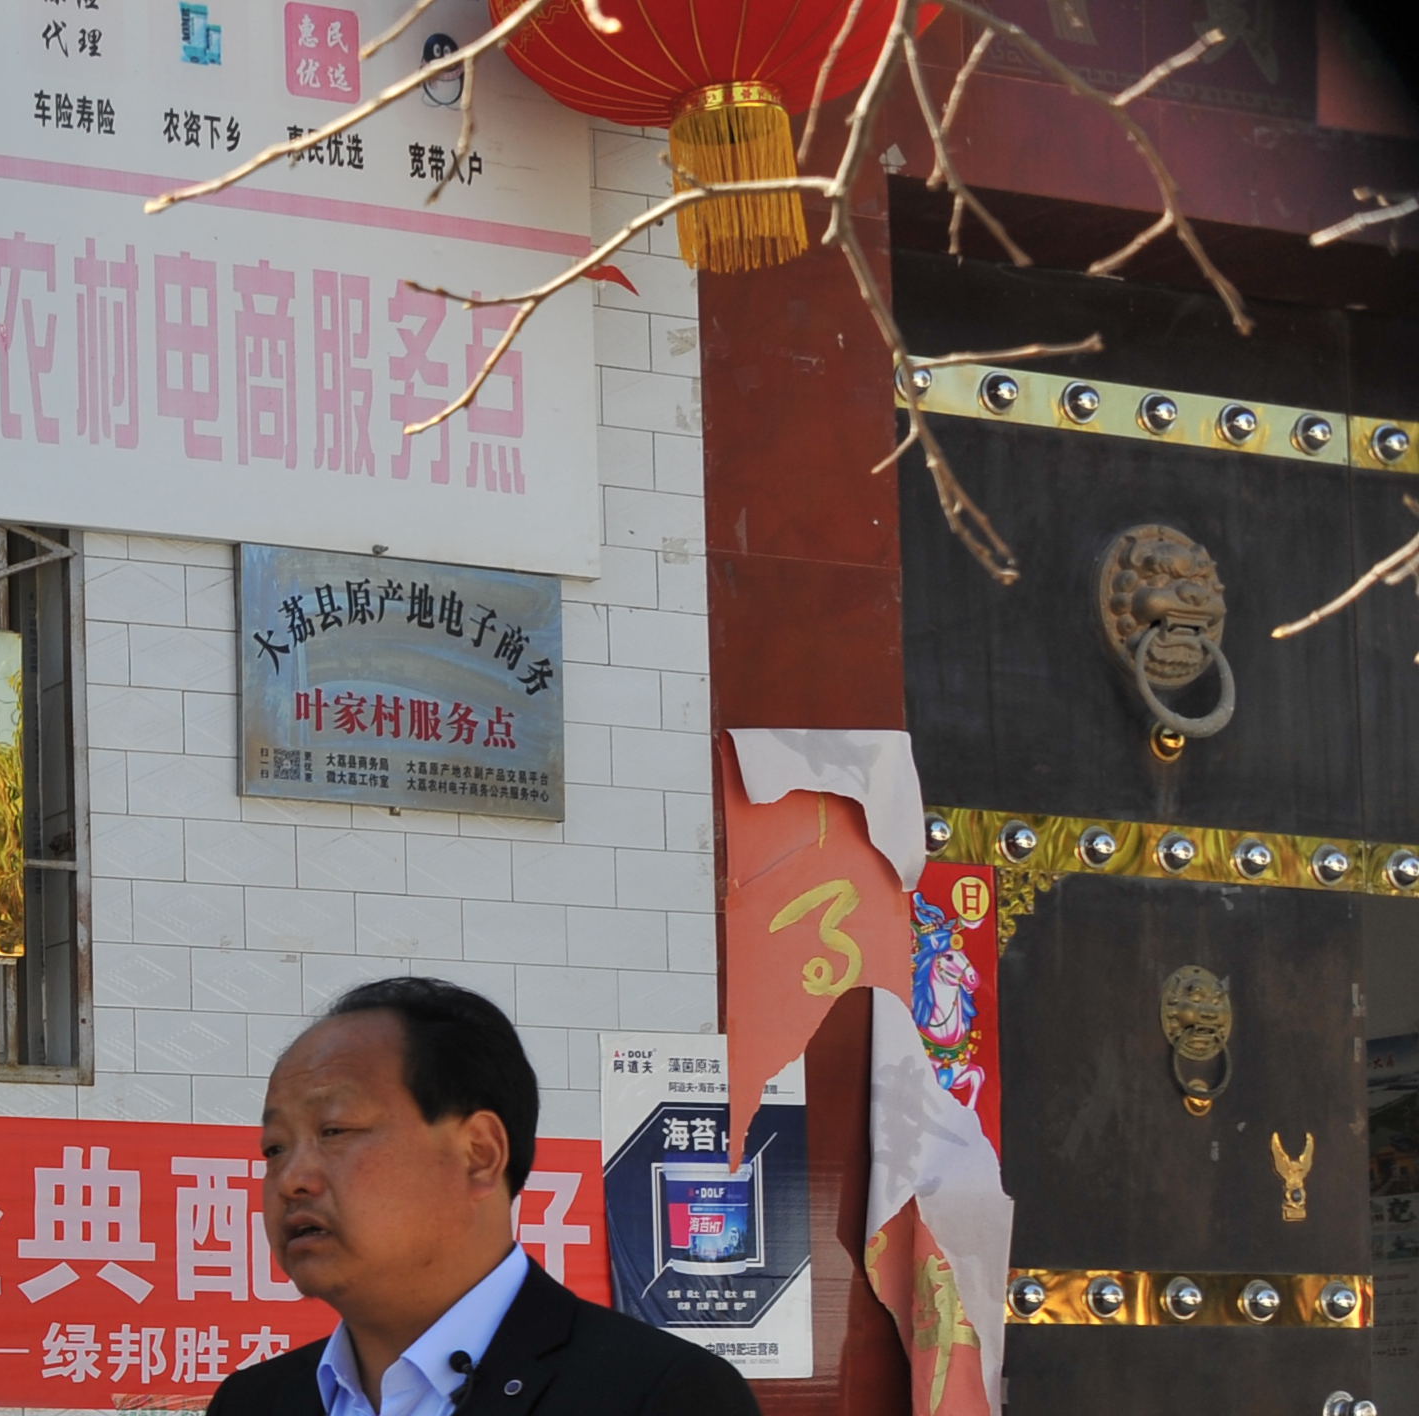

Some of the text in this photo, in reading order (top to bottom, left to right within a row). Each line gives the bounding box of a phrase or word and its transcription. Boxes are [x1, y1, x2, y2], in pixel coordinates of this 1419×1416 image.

[41, 19, 103, 58] 代理
[297, 13, 351, 54] 惠民
[295, 57, 353, 93] 优选
[34, 88, 116, 136] 车险寿险
[162, 106, 243, 153] 农资下乡
[408, 141, 484, 186] 宽带入户
[252, 577, 554, 697] 大荔县原产地电子商务
[294, 687, 517, 750] 叶家村服务点
